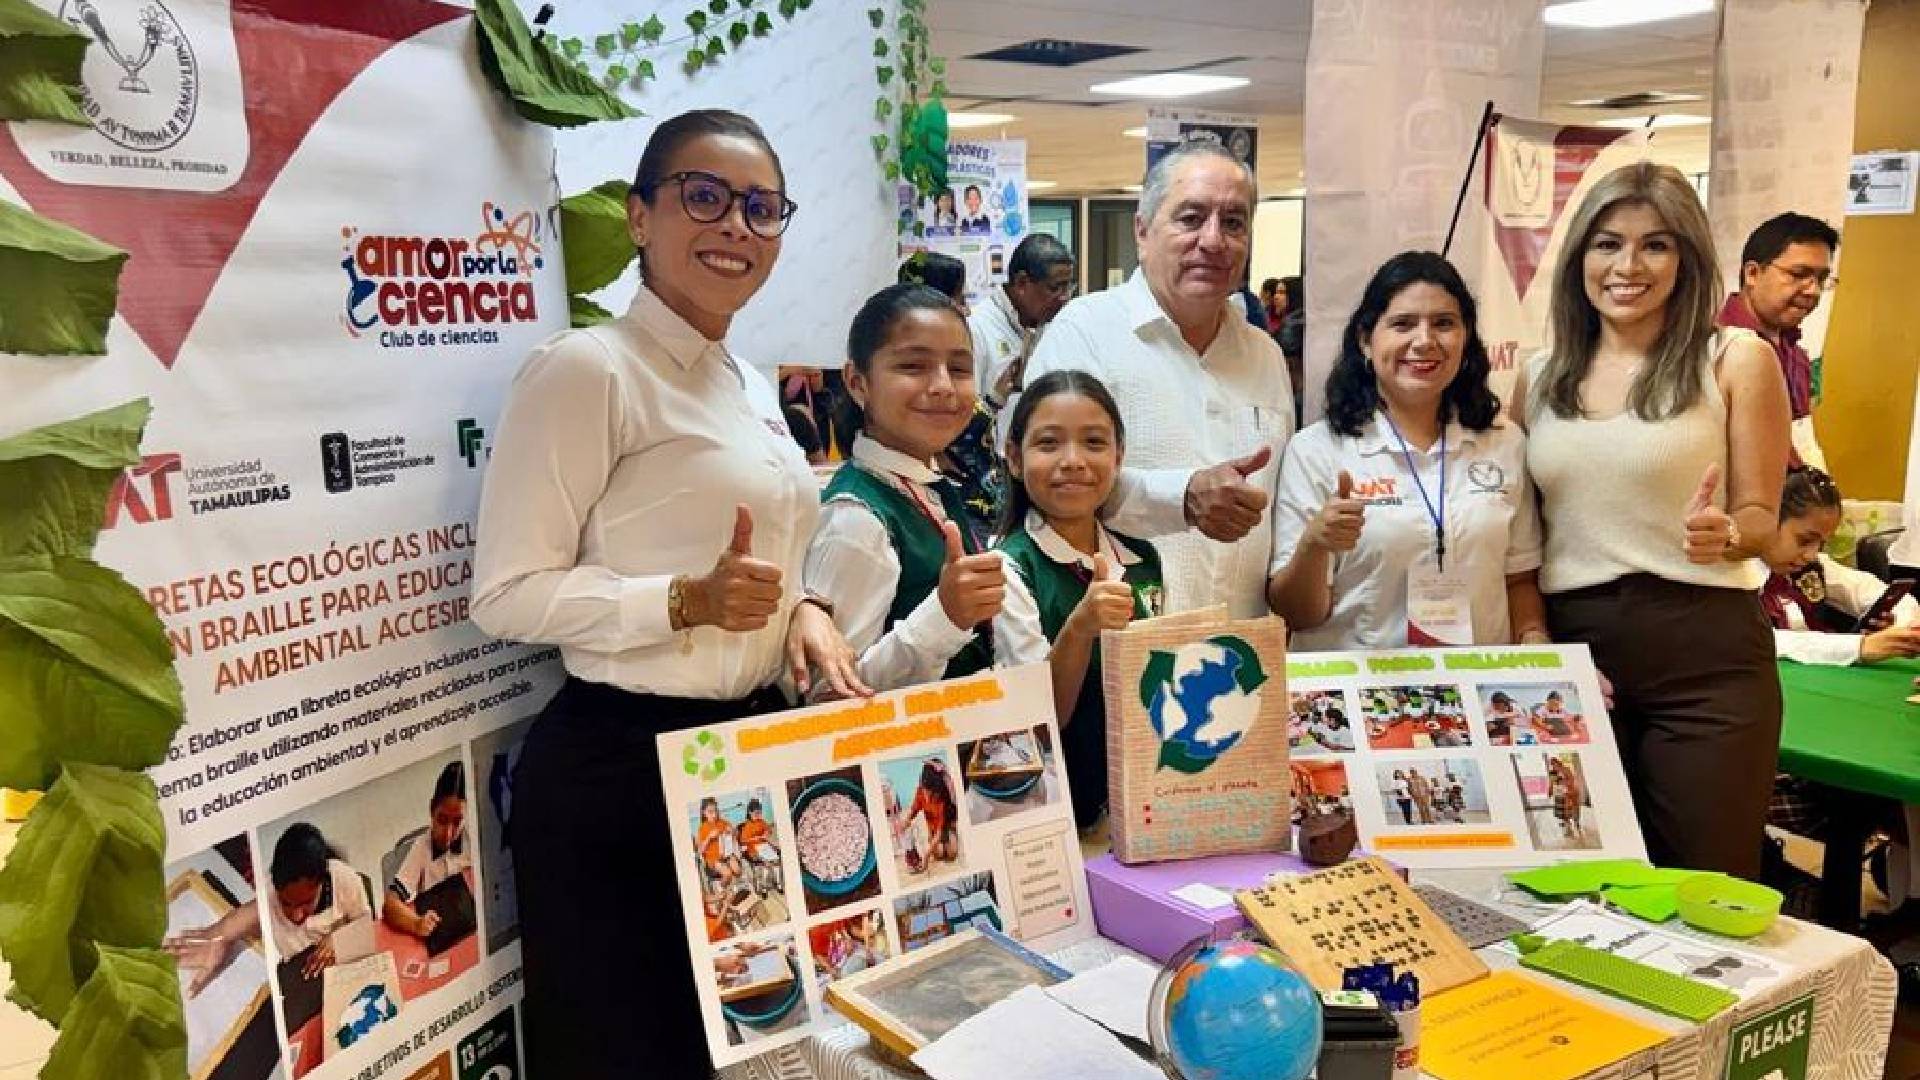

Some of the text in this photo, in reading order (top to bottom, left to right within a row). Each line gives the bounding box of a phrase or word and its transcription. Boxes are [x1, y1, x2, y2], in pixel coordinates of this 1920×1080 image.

[356, 236, 518, 279] amor por la
[378, 280, 539, 326] ciencia
[379, 328, 500, 348] Club de ciencias
[102, 453, 182, 530] AT
[185, 458, 263, 483] Universidad
[189, 484, 292, 515] TAMAULIPAS
[259, 471, 277, 486] de
[148, 521, 477, 617] RETAS ECOLÓGICAS INCL
[167, 558, 475, 657] N BRAILLE PARA EDUCA
[213, 596, 470, 696] AMBIENTAL ACCESIB
[188, 716, 263, 756] Elaborar
[266, 705, 300, 728] una
[300, 687, 351, 717] libreta
[353, 664, 422, 698] ecológica
[424, 646, 480, 676] inclusiva
[205, 749, 260, 783] braille
[261, 721, 340, 761] utilizando
[342, 696, 419, 732] materiales
[419, 669, 486, 705] reciclados
[487, 659, 516, 684] para
[178, 806, 198, 826] la
[201, 770, 290, 819] educación
[290, 738, 370, 782] ambiental
[370, 737, 381, 755] y
[383, 728, 398, 747] el
[399, 699, 477, 742] aprendizaje
[1739, 1009, 1808, 1064] PLEASE
